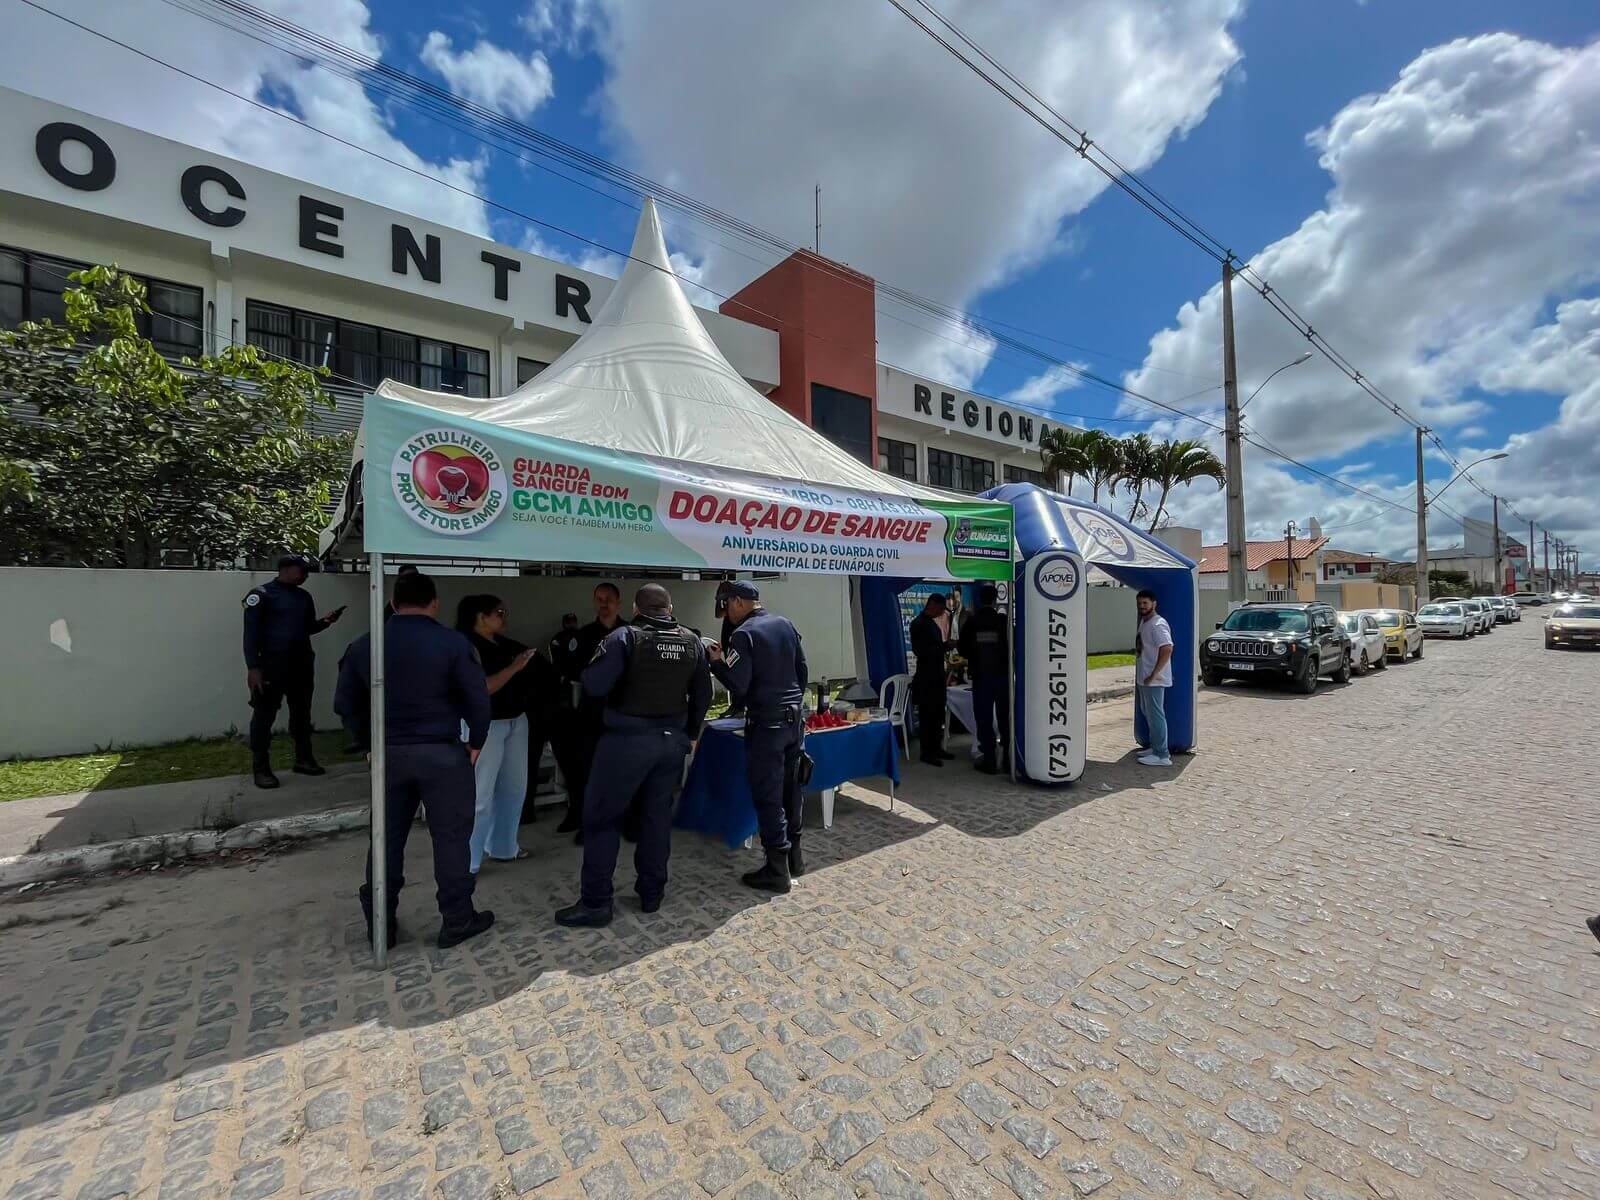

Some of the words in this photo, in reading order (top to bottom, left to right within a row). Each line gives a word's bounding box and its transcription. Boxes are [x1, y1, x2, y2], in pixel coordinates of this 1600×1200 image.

[400, 431, 500, 471] PATRULHEIRO
[513, 457, 591, 481] GUARDA
[512, 473, 588, 496] SANGUE
[591, 484, 629, 500] BOM
[397, 472, 460, 530] PROTETOR
[473, 490, 502, 527] AMIGO
[512, 490, 572, 514] GCM
[577, 498, 653, 522] AMIGO
[512, 512, 537, 522] SEJA
[612, 521, 626, 530] UM
[668, 491, 803, 535] DOAÇÃO
[803, 509, 837, 535] DE
[841, 515, 932, 542] SANGUE
[722, 536, 808, 553] ANIVERSÁRIO
[811, 543, 827, 555] DA
[830, 545, 874, 558] GUARDA
[877, 549, 900, 560] CIVIL
[741, 553, 809, 569] MUNICIPAL
[812, 558, 827, 570] DE
[828, 558, 885, 572] EUNÁPOLIS
[656, 643, 685, 652] GUARDA
[661, 651, 681, 660] CIVIL
[1048, 608, 1067, 725] 3261-1757
[1048, 734, 1071, 778] (73)
